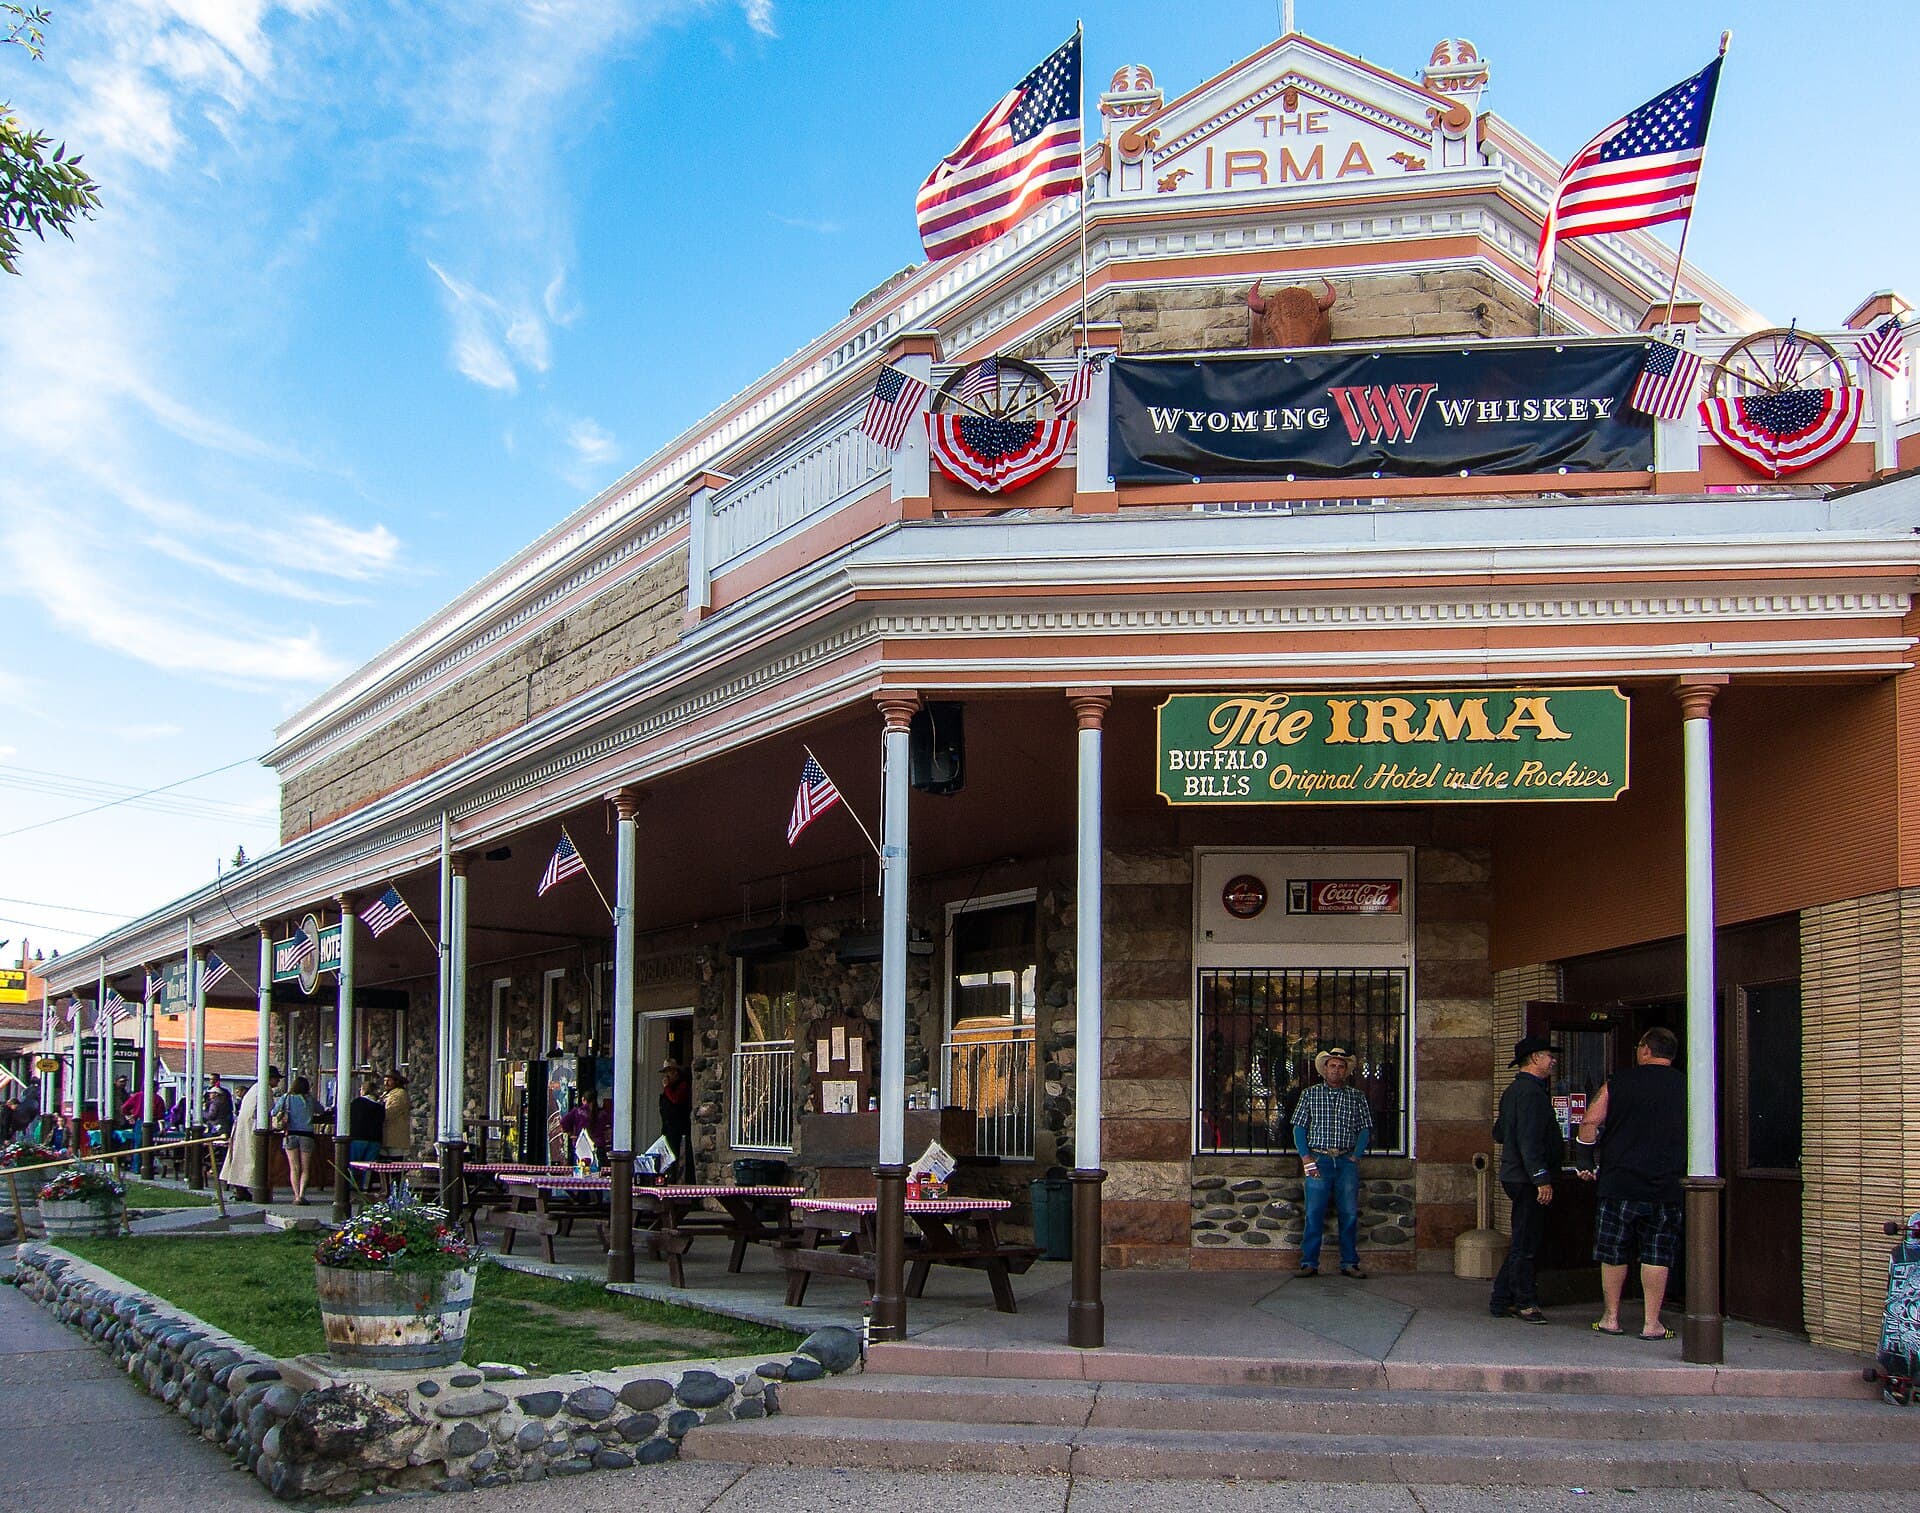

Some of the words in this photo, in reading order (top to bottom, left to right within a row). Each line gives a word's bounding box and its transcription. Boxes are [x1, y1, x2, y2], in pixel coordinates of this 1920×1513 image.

[1255, 111, 1329, 138] THE
[1205, 142, 1374, 189] IRMA
[1147, 406, 1330, 434] WYOMING
[1436, 397, 1614, 427] WHISKEY
[1208, 693, 1314, 750] The
[1323, 696, 1573, 744] IRMA
[1168, 749, 1268, 771] BUFFALO
[1183, 774, 1251, 797] BILL'S
[1268, 763, 1363, 798] Original
[1363, 762, 1442, 789] Hotel
[1443, 767, 1466, 789] in
[1469, 762, 1509, 789] the
[1513, 760, 1613, 788] Rockies
